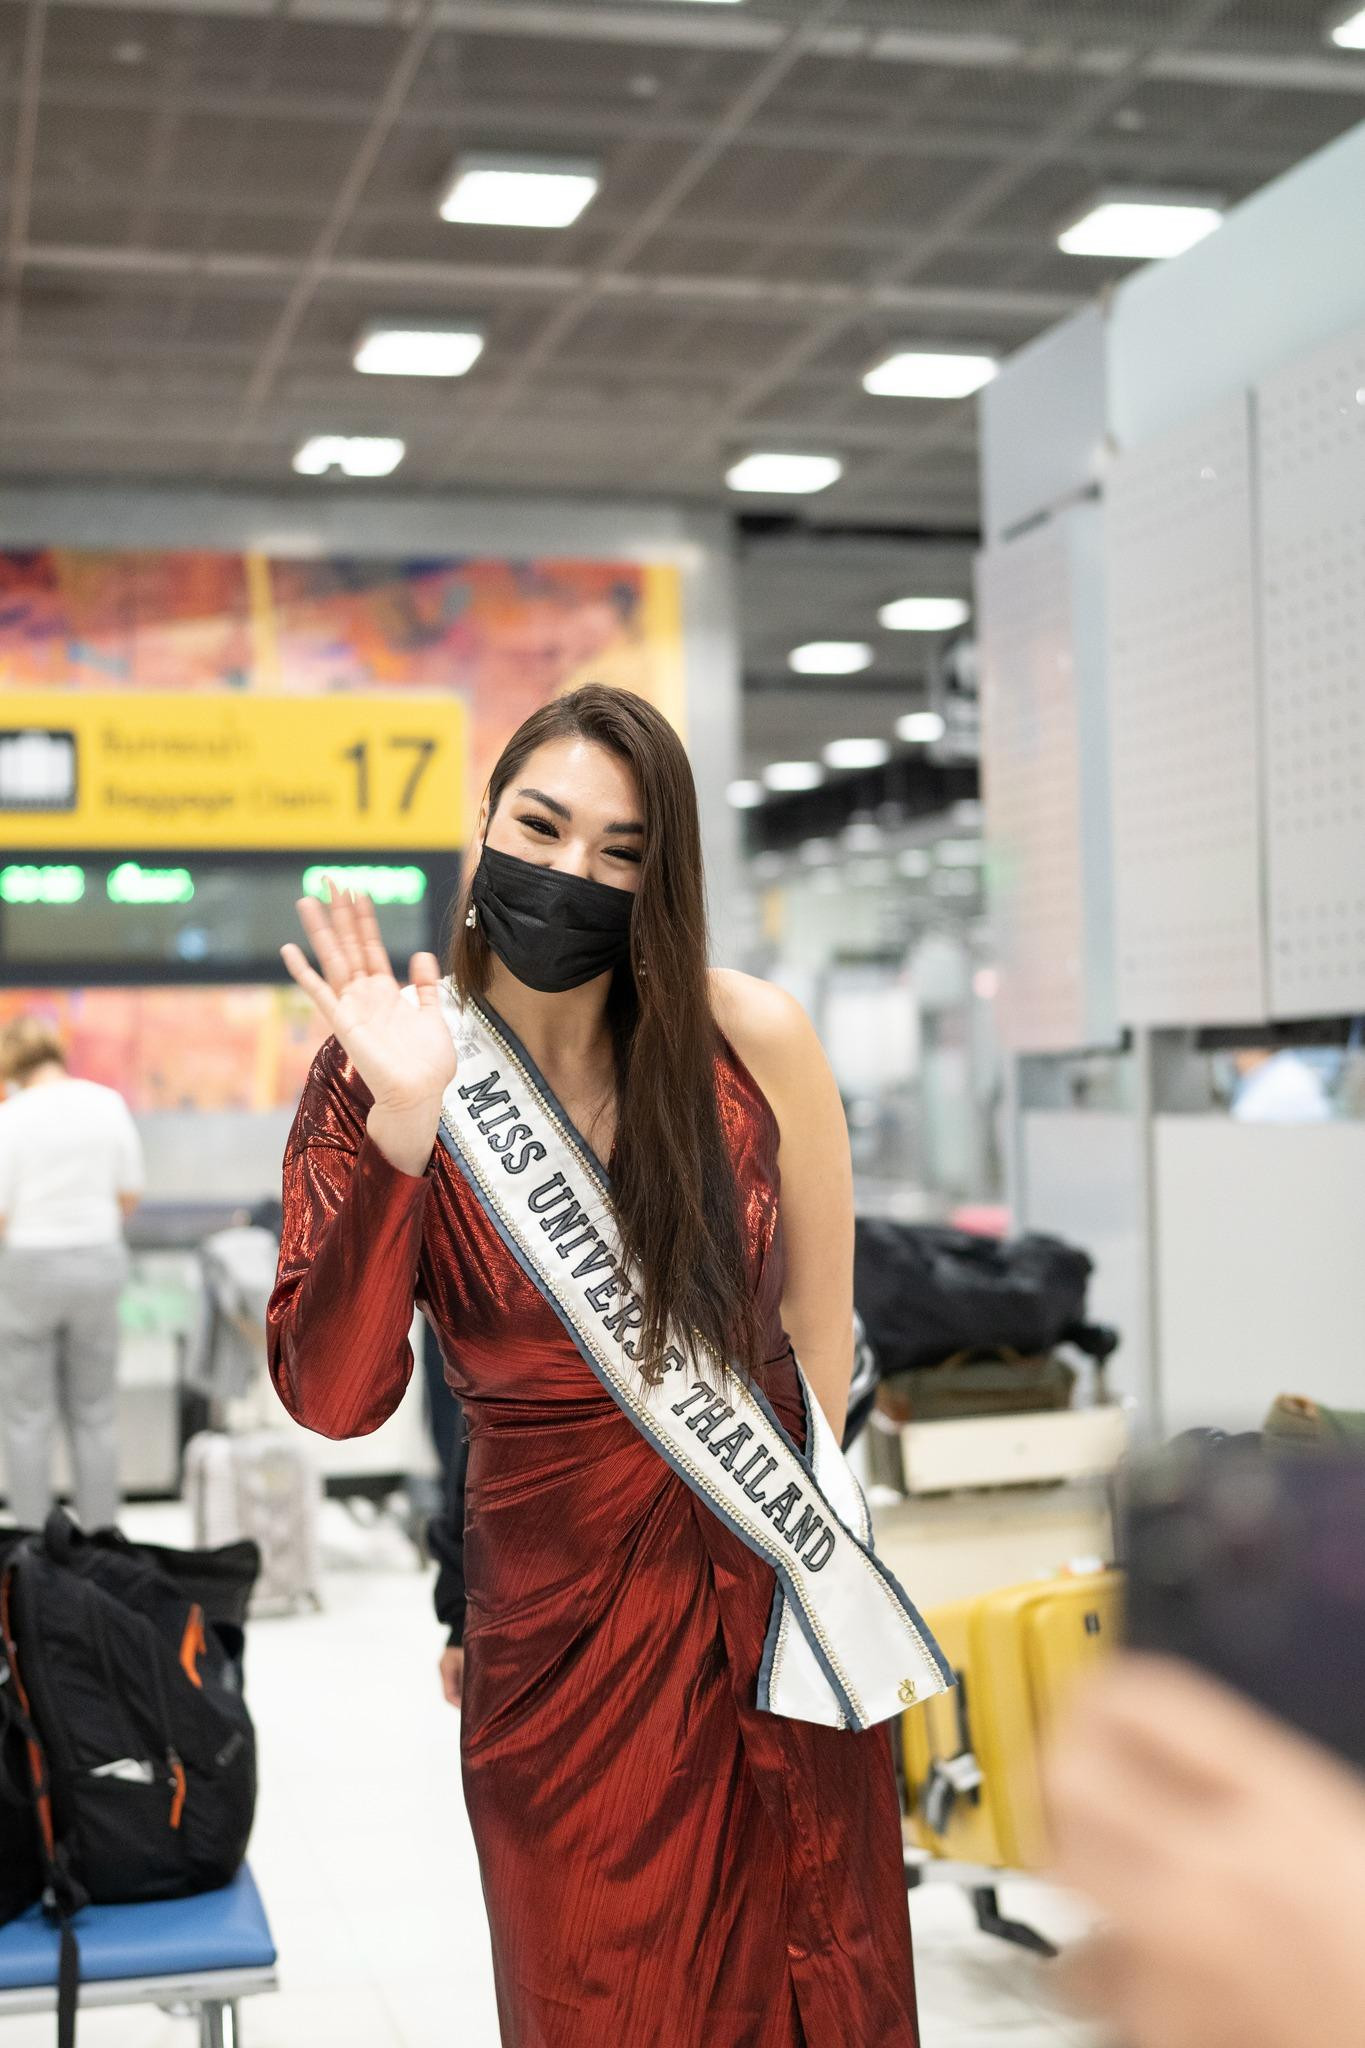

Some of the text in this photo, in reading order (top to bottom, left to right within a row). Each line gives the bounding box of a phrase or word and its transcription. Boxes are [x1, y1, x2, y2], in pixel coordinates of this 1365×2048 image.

[341, 735, 438, 815] 17
[457, 1070, 548, 1175] MISS
[670, 1380, 836, 1573] THAILAND
